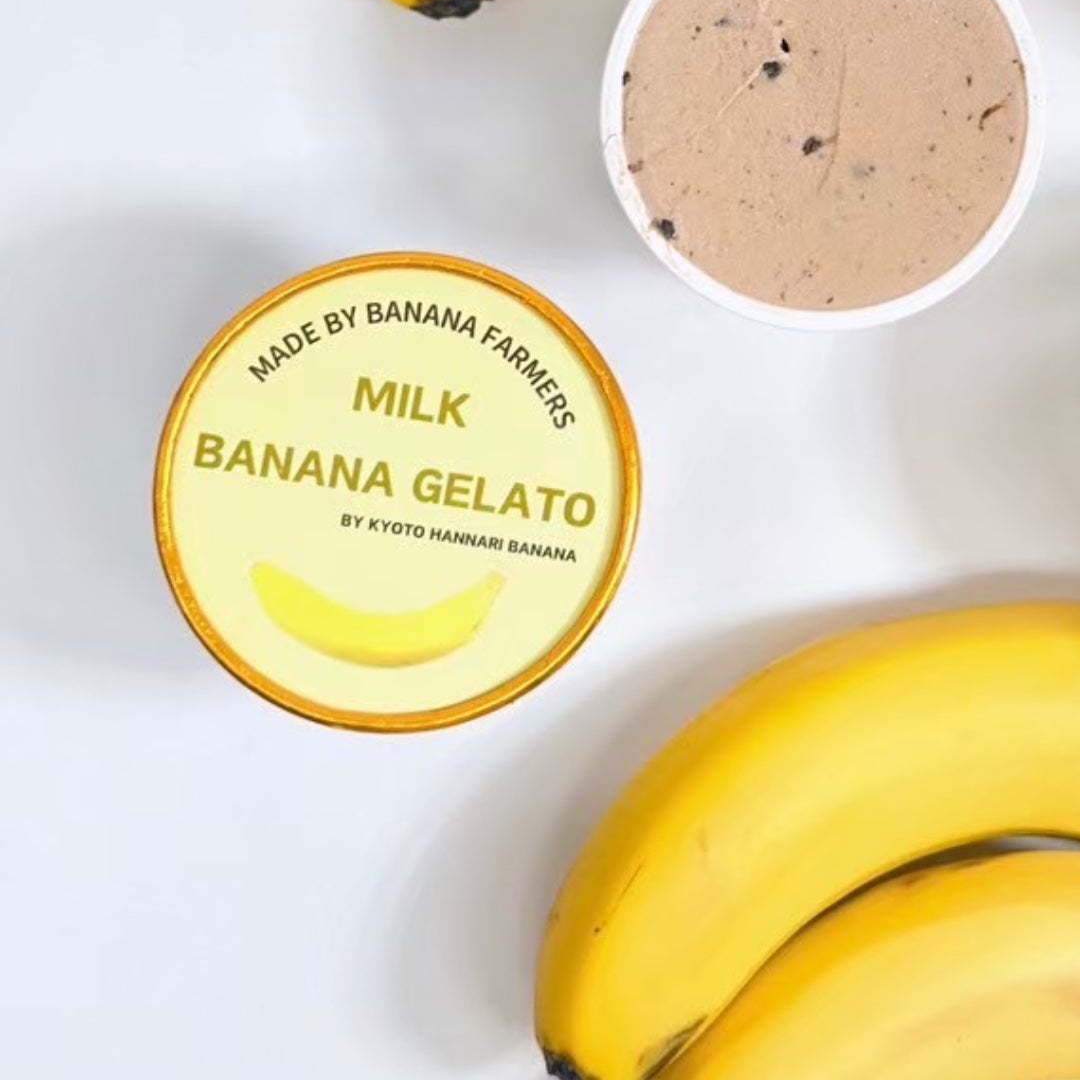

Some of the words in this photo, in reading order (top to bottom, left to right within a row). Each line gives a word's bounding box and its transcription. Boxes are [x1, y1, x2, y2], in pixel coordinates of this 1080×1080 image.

[248, 322, 321, 382] MADE
[324, 306, 357, 334] BY
[366, 301, 476, 339] BANANA
[480, 325, 575, 430] FARMERS
[353, 377, 471, 428] MILK
[194, 433, 394, 497] BANANA
[412, 468, 596, 528] GELATO
[341, 514, 363, 528] BY
[368, 517, 425, 539] KYOTO
[430, 527, 503, 550] HANNARI
[508, 539, 577, 563] BANANA
